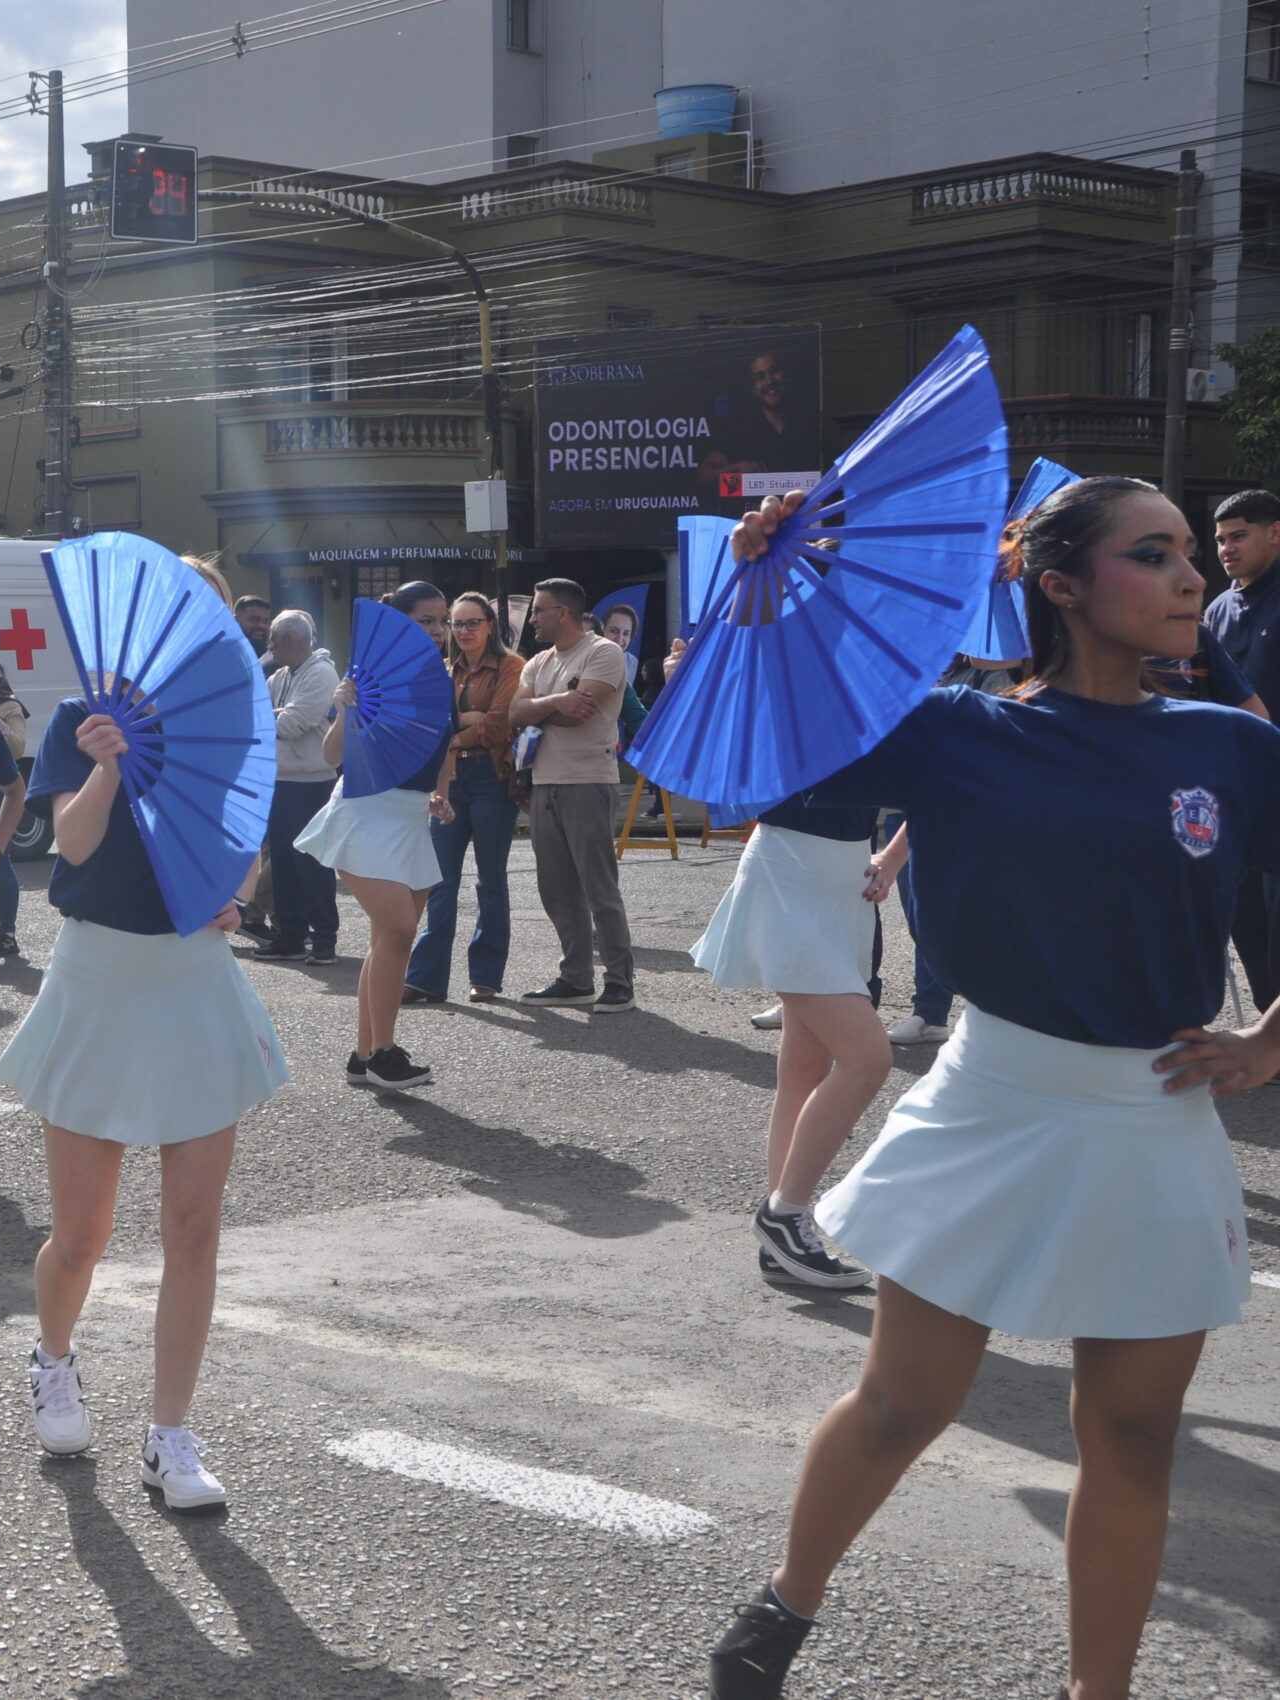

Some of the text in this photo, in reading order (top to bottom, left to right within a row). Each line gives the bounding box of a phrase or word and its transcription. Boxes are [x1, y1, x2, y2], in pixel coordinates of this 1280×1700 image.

[569, 364, 644, 381] SOBERANA
[548, 417, 711, 442] ODONTOLOGIA
[549, 445, 699, 472] PRESENCIAL
[748, 480, 765, 489] LED
[769, 480, 801, 489] Studio
[548, 496, 699, 512] AGORA EM URUGUAIANA
[308, 547, 523, 561] MAQUIAGEM PERFUMARIA CURARIA
